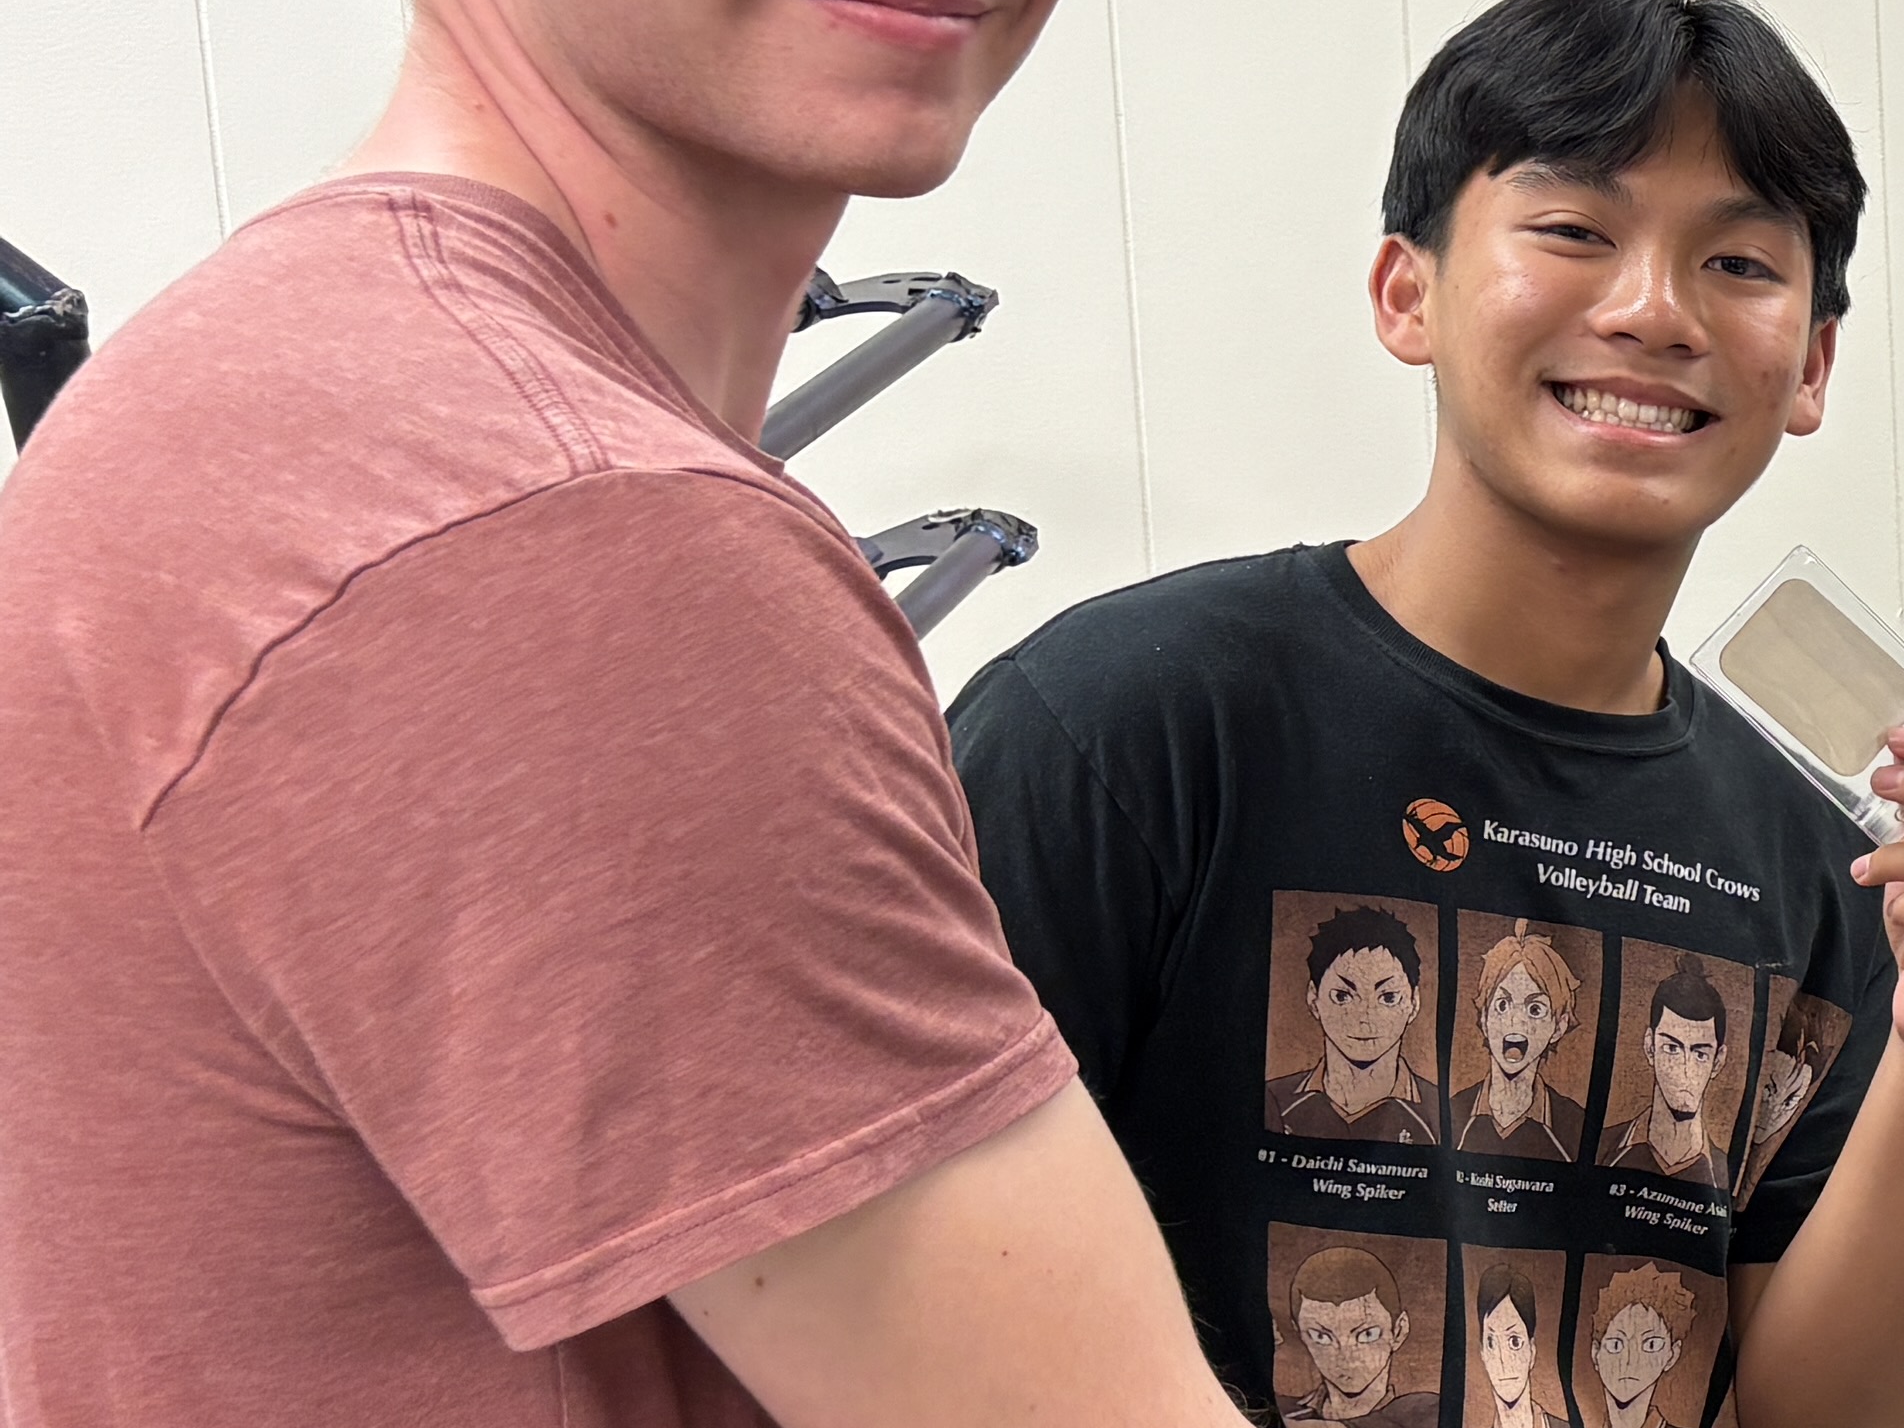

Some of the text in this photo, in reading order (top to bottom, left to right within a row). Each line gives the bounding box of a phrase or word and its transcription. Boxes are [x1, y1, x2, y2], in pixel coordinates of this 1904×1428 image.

[1483, 819, 1761, 902] Karasuno High School Crows
[1536, 863, 1692, 914] Volleyball Team
[1291, 1154, 1344, 1172] Daichi
[1347, 1158, 1429, 1179] Sawamura
[1312, 1178, 1406, 1202] Wing Spiker
[1636, 1186, 1705, 1213] Azumane
[1624, 1205, 1709, 1235] Wing Spiker
